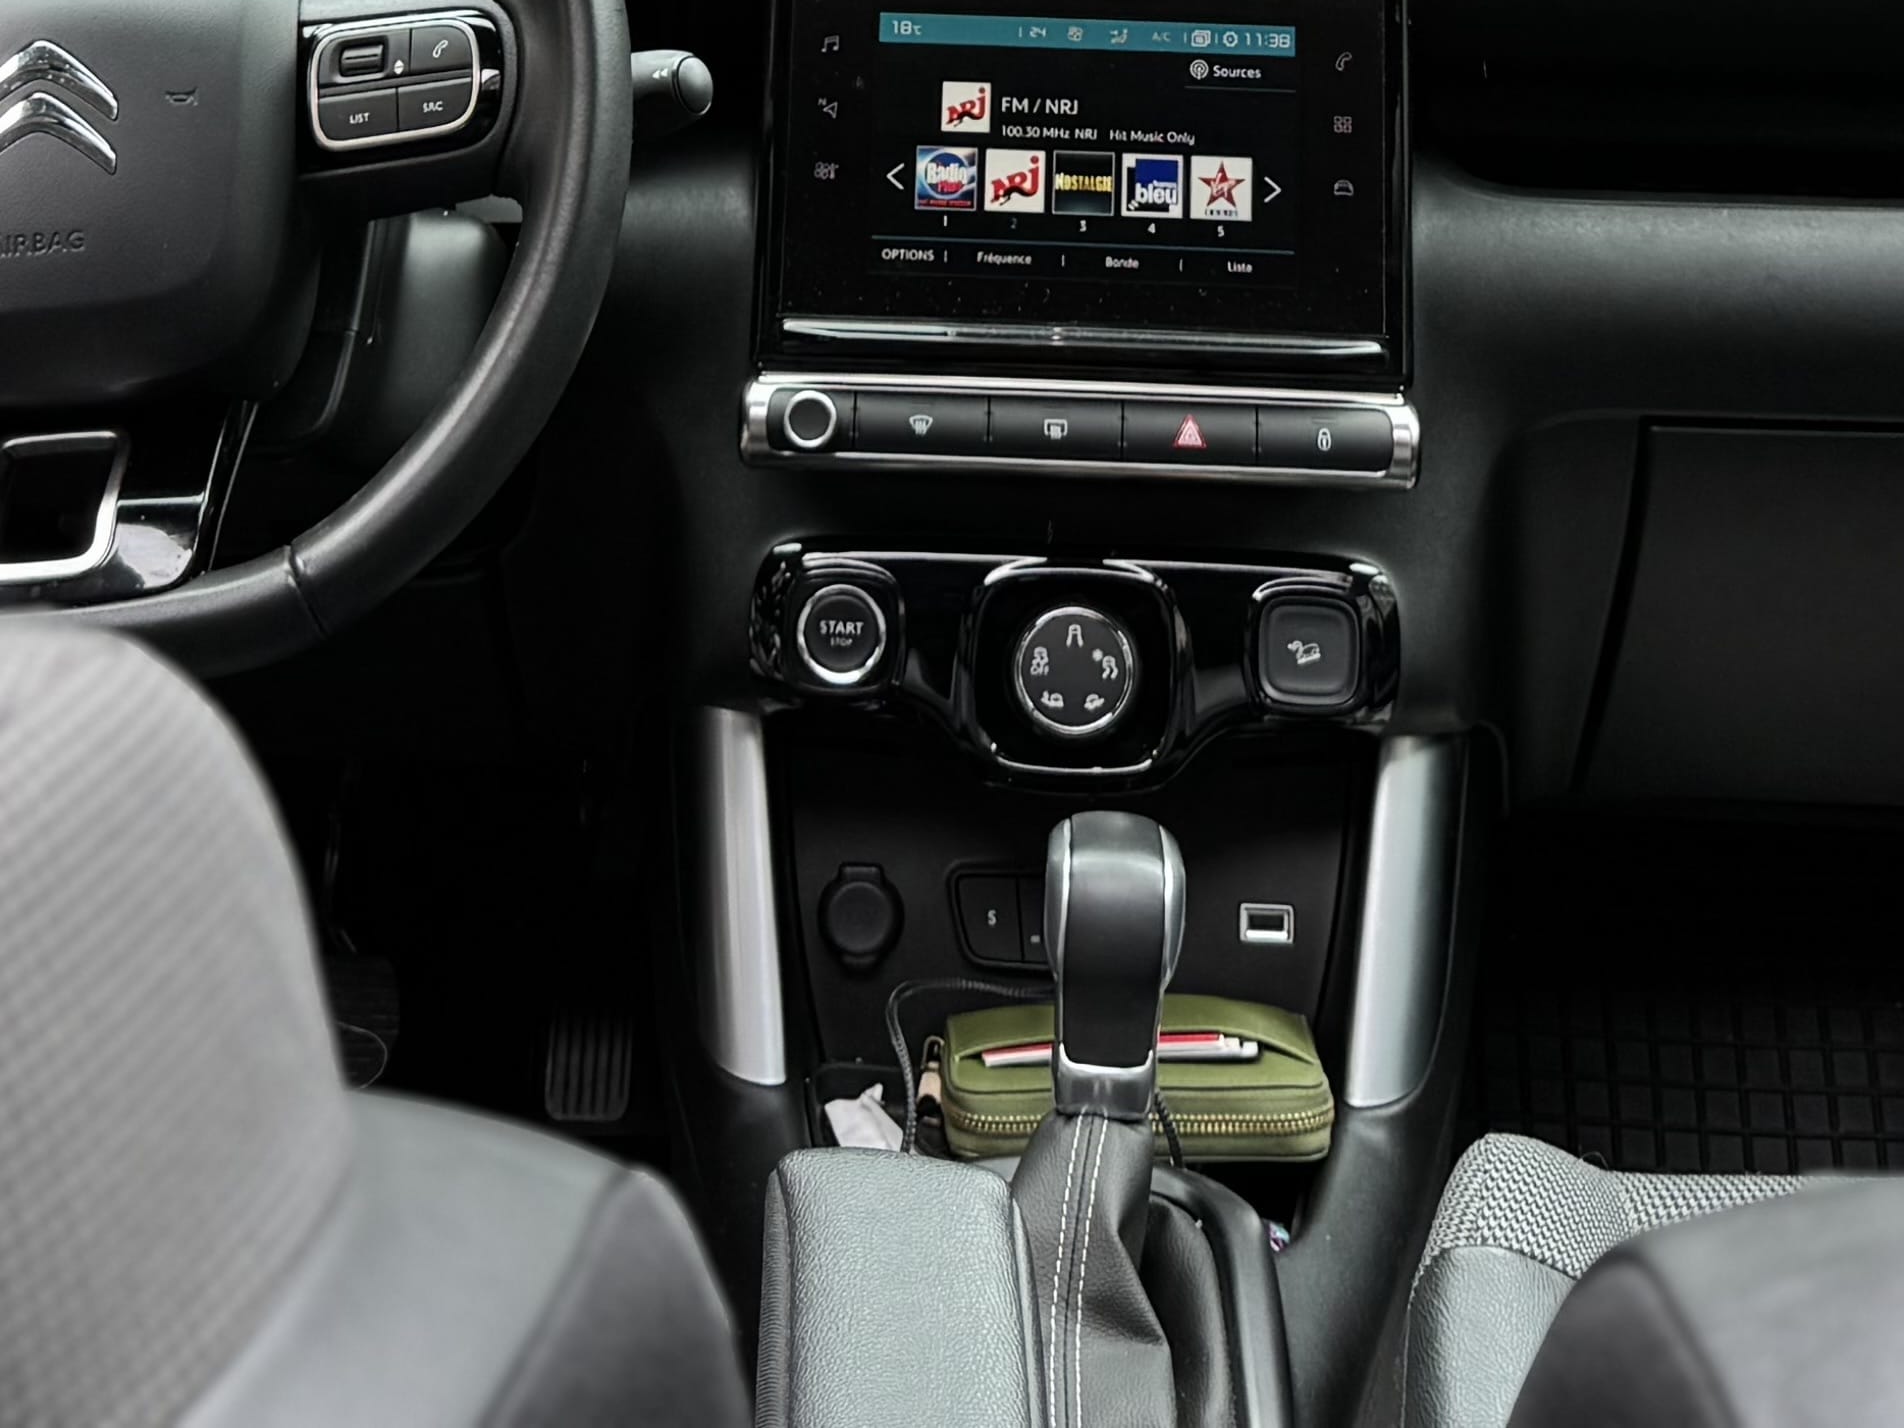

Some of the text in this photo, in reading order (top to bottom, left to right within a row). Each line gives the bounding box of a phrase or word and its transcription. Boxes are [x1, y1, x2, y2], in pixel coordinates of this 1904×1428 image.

[1244, 32, 1291, 49] 11:38
[1212, 64, 1262, 79] Sources
[422, 100, 444, 113] SRC
[1001, 96, 1029, 113] FM
[1045, 98, 1079, 115] NRJ
[349, 111, 371, 124] LIST
[1042, 126, 1070, 139] MHz
[1074, 127, 1098, 140] NRJ
[1109, 129, 1128, 141] Hit
[1130, 130, 1164, 143] Music
[1167, 131, 1196, 146] Only
[1055, 172, 1113, 192] NOSTALGIE
[1135, 182, 1177, 205] bleu
[1010, 217, 1018, 230] 2
[1078, 219, 1087, 232] 3
[1147, 223, 1157, 234] 4
[1216, 225, 1225, 238] 5
[880, 247, 935, 262] OPTIONS
[976, 251, 1033, 266] Fréquence
[819, 619, 864, 636] START
[986, 909, 998, 926] S
